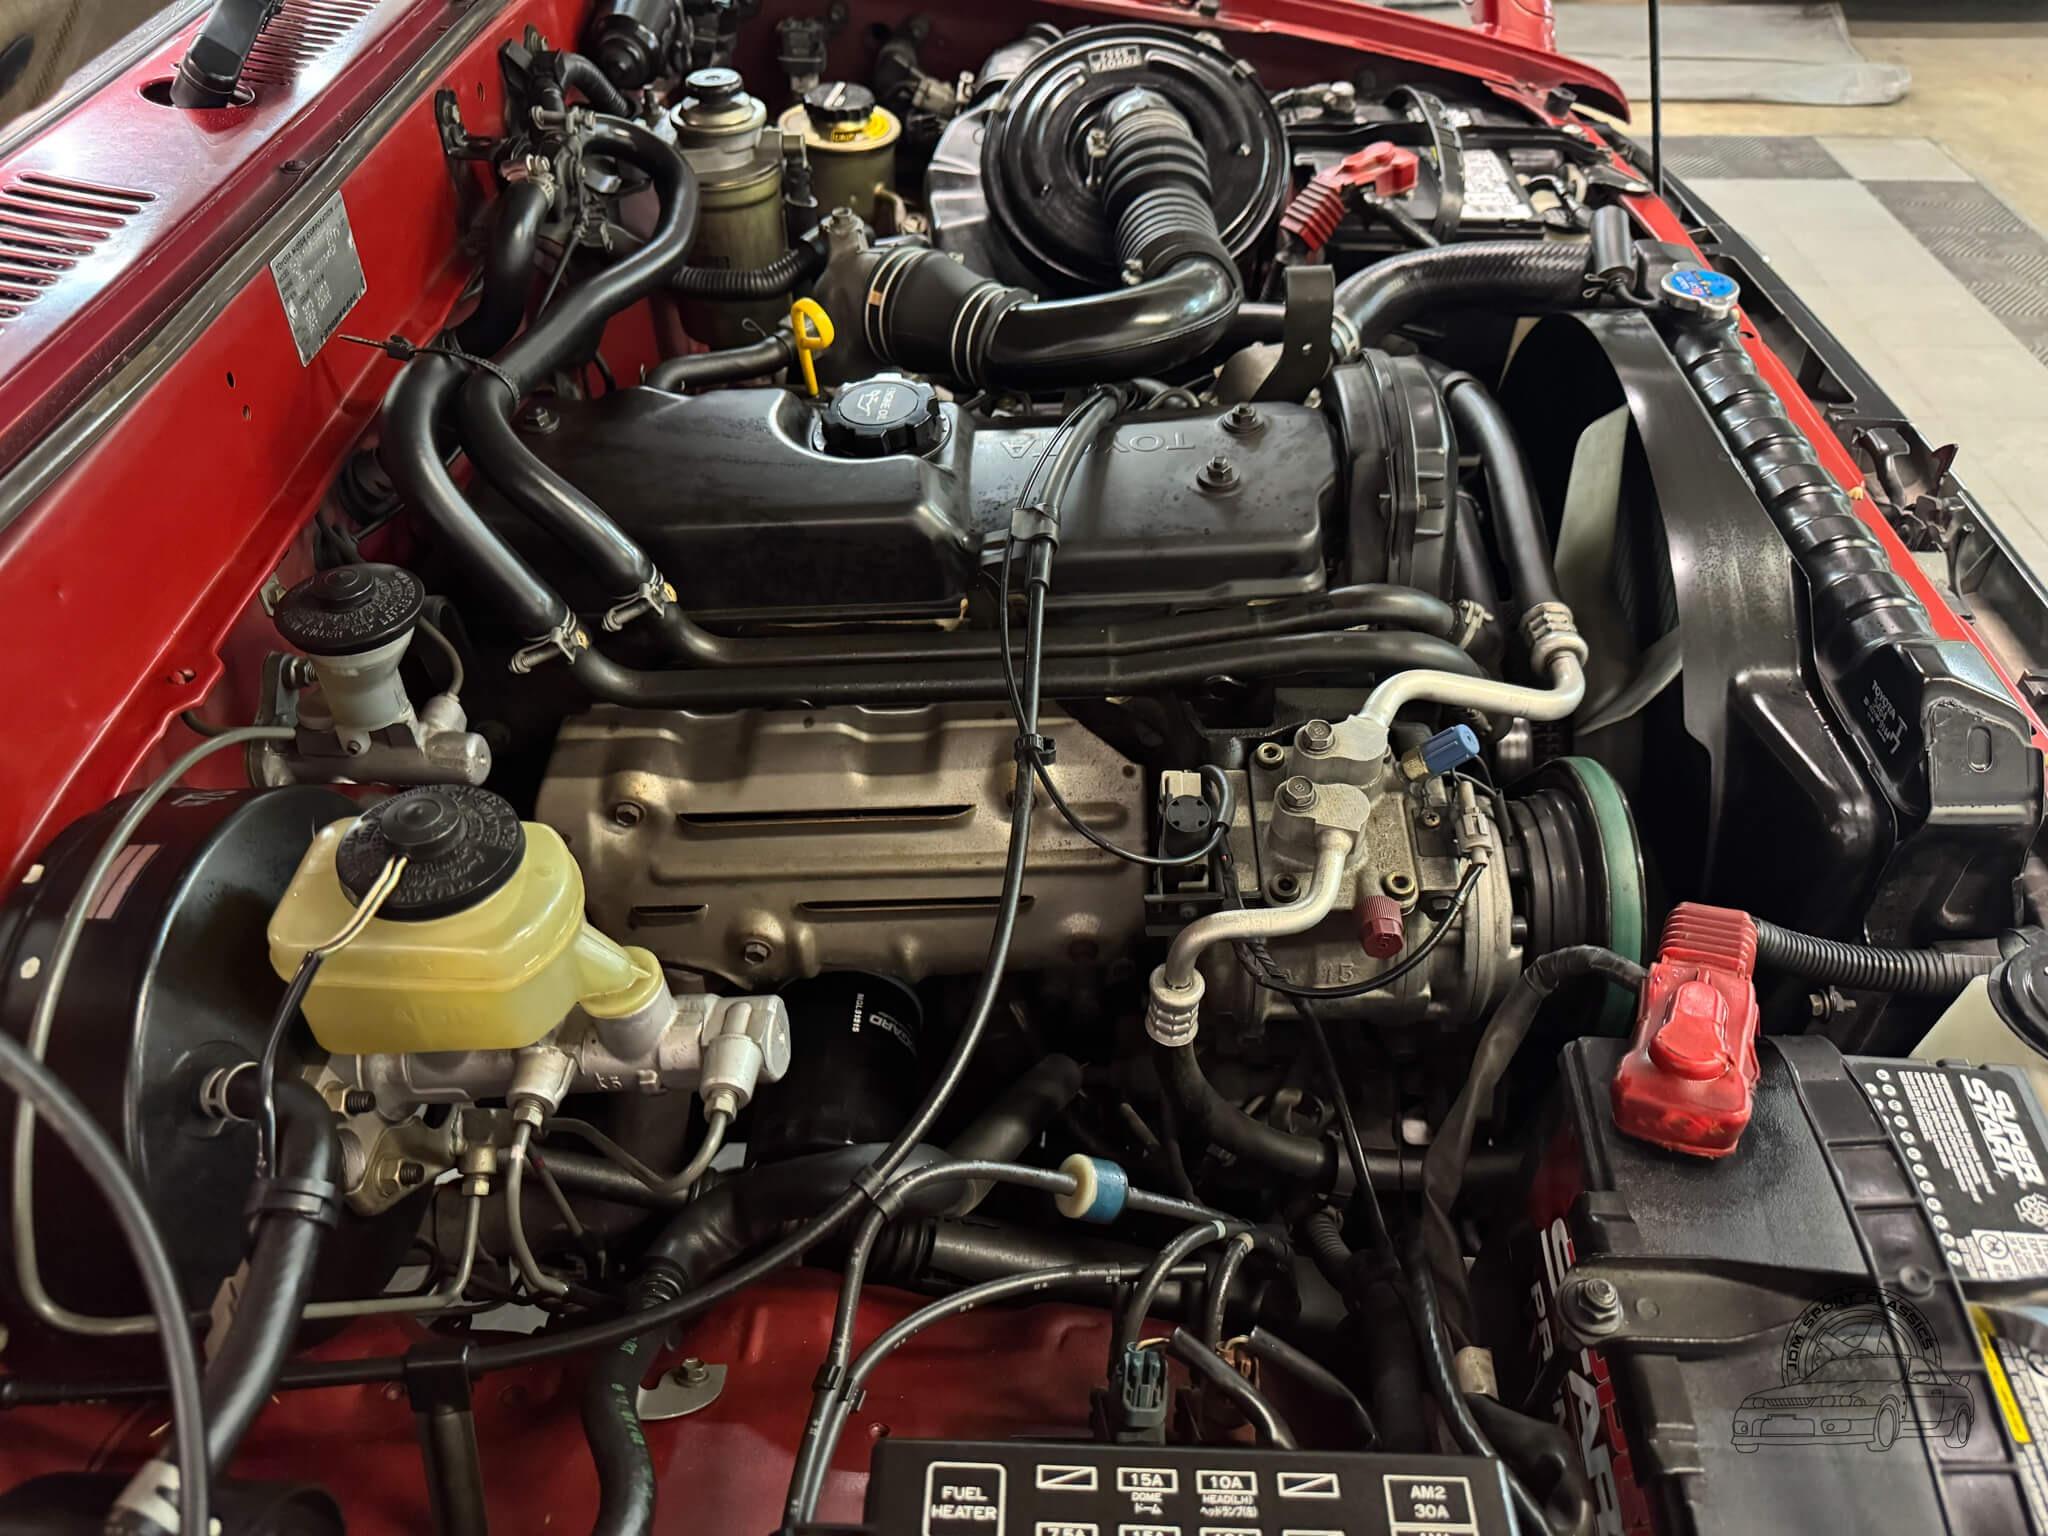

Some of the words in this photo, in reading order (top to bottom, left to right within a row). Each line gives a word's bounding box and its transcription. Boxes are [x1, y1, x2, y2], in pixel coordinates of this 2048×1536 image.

[997, 431, 1197, 459] TOYTA
[1959, 1073, 2026, 1186] START
[1994, 1088, 2047, 1186] SUPER
[1130, 1472, 1164, 1488] 15A
[1209, 1475, 1244, 1490] 10A
[941, 1486, 988, 1501] FUEL
[1131, 1491, 1163, 1502] DOME
[1410, 1484, 1447, 1500] AM2
[931, 1504, 997, 1520] HEATER
[1414, 1503, 1449, 1519] 30A
